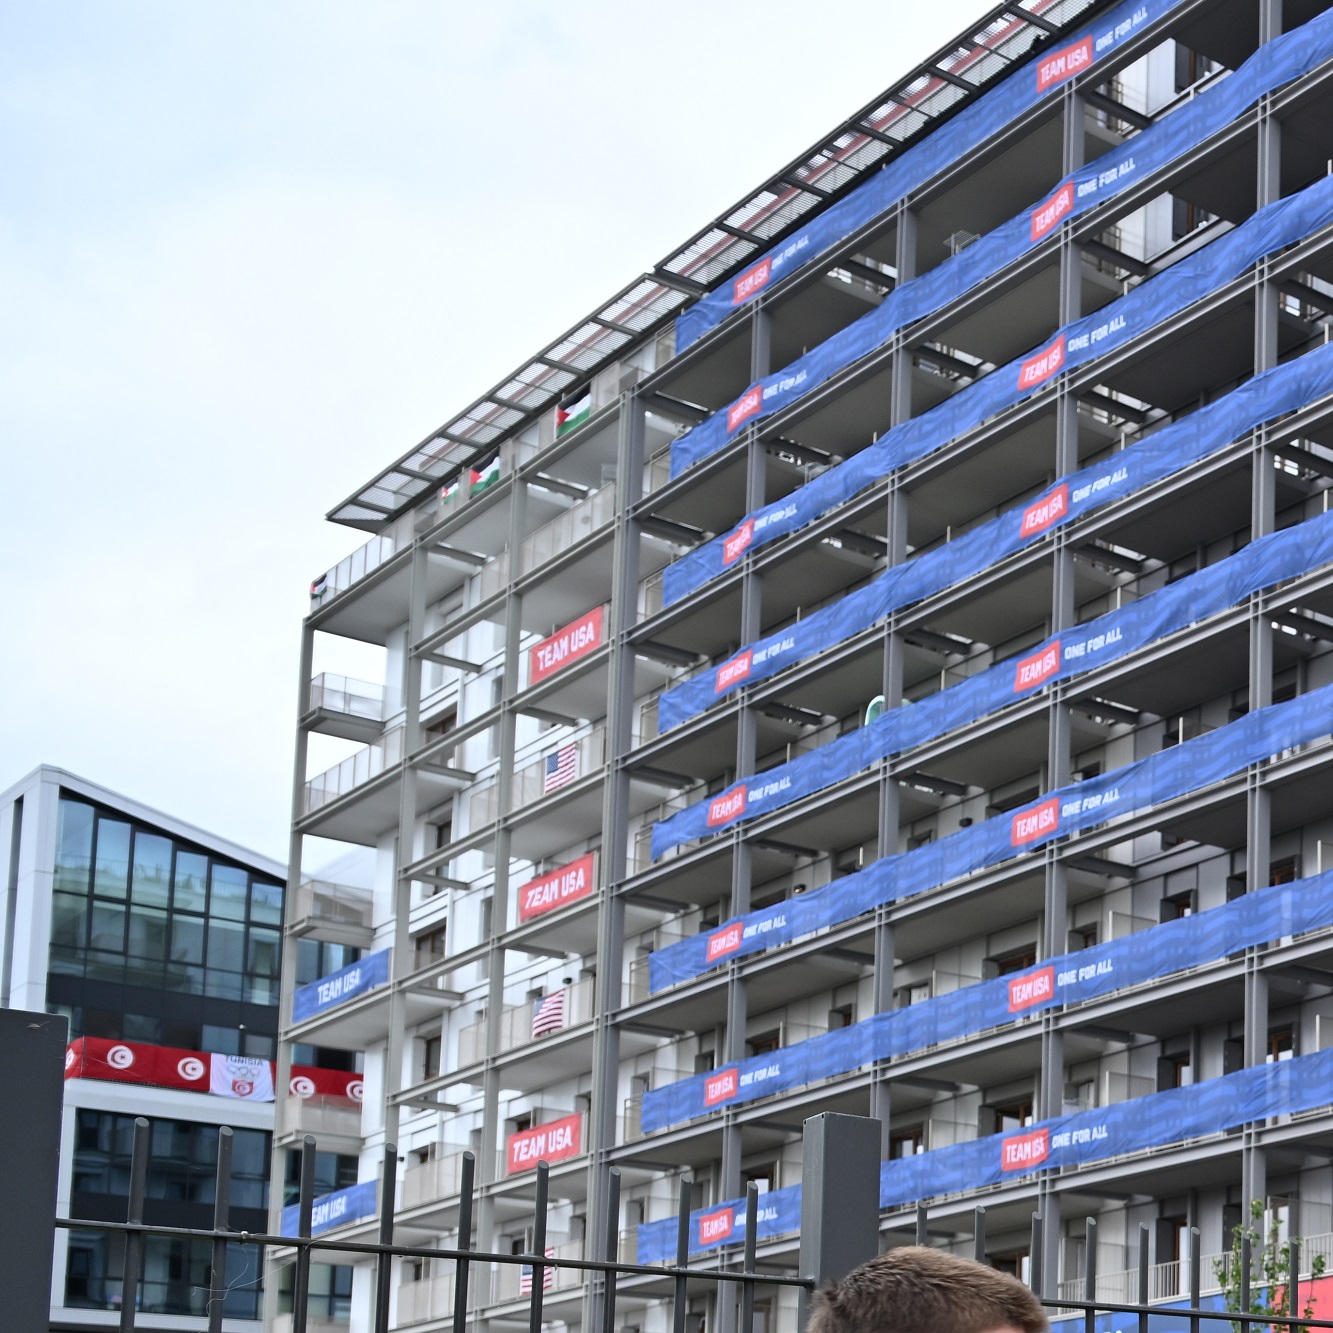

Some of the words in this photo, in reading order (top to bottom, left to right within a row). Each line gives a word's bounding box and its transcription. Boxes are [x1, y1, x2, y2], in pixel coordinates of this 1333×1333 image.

[1095, 31, 1112, 50] ONE
[1112, 20, 1130, 41] FOR
[1131, 7, 1148, 27] ALL
[1041, 57, 1065, 83] TEAM
[1066, 45, 1089, 71] USA
[1068, 334, 1089, 353] ONE
[1090, 325, 1110, 342] FOR
[1111, 314, 1126, 334] ALL
[1024, 357, 1047, 382] TEAM
[1048, 344, 1062, 370] USA
[537, 642, 569, 671] TEAM
[571, 621, 595, 651] USA
[1064, 643, 1085, 660] ONE
[1086, 635, 1105, 653] FOR
[1105, 625, 1122, 647] ALL
[1020, 658, 1040, 683] TEAM
[1040, 648, 1056, 676] USA
[1015, 813, 1038, 838] TEAM
[1038, 805, 1055, 829] USA
[1062, 801, 1081, 818] ONE
[1082, 795, 1100, 812] FOR
[1103, 788, 1120, 805] ALL
[525, 884, 558, 910] TEAM
[562, 867, 586, 894] USA
[317, 979, 342, 1004] TEAM
[343, 967, 362, 991] USA
[1012, 981, 1032, 1004] TEAM
[1032, 974, 1050, 999] USA
[1058, 970, 1078, 987] ONE
[1078, 966, 1096, 982] FOR
[1097, 958, 1113, 978] ALL
[513, 1136, 546, 1163] TEAM
[548, 1124, 572, 1150] USA
[311, 1206, 329, 1227] EAM
[330, 1195, 347, 1218] USA
